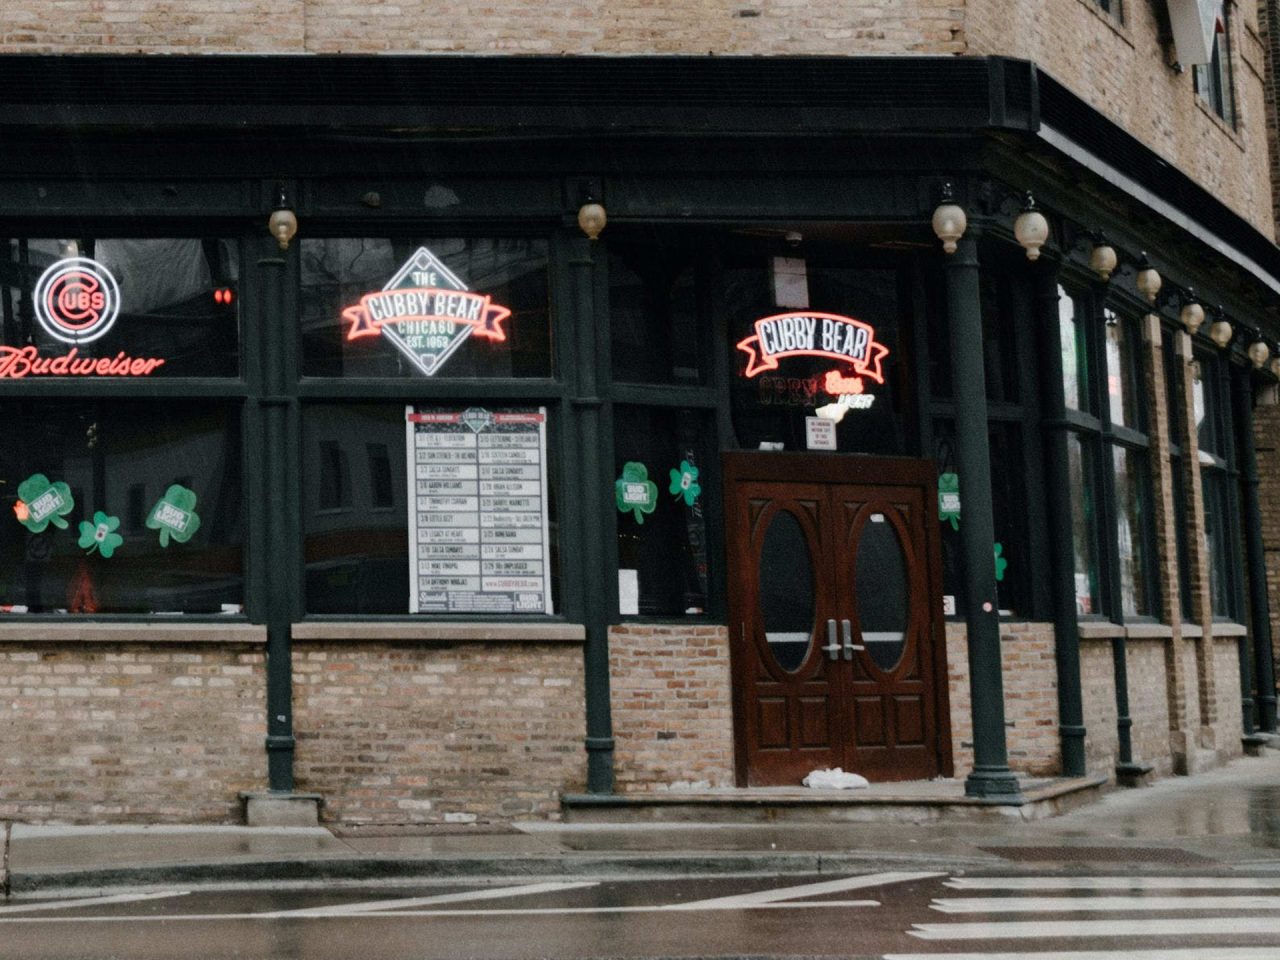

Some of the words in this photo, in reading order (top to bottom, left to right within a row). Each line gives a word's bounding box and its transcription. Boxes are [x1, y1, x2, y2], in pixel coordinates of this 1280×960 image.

[413, 271, 437, 286] THE
[368, 292, 428, 321] CUBBY
[434, 292, 483, 321] BEAR
[397, 321, 455, 335] CHICAGO
[760, 317, 816, 355] CUBBY
[822, 319, 867, 359] BEAR
[624, 492, 648, 501] LIGHT
[627, 484, 645, 493] BUD
[32, 493, 53, 511] BUD
[33, 498, 62, 520] LIGHT
[156, 510, 186, 530] LIGHT
[163, 504, 184, 522] BUD
